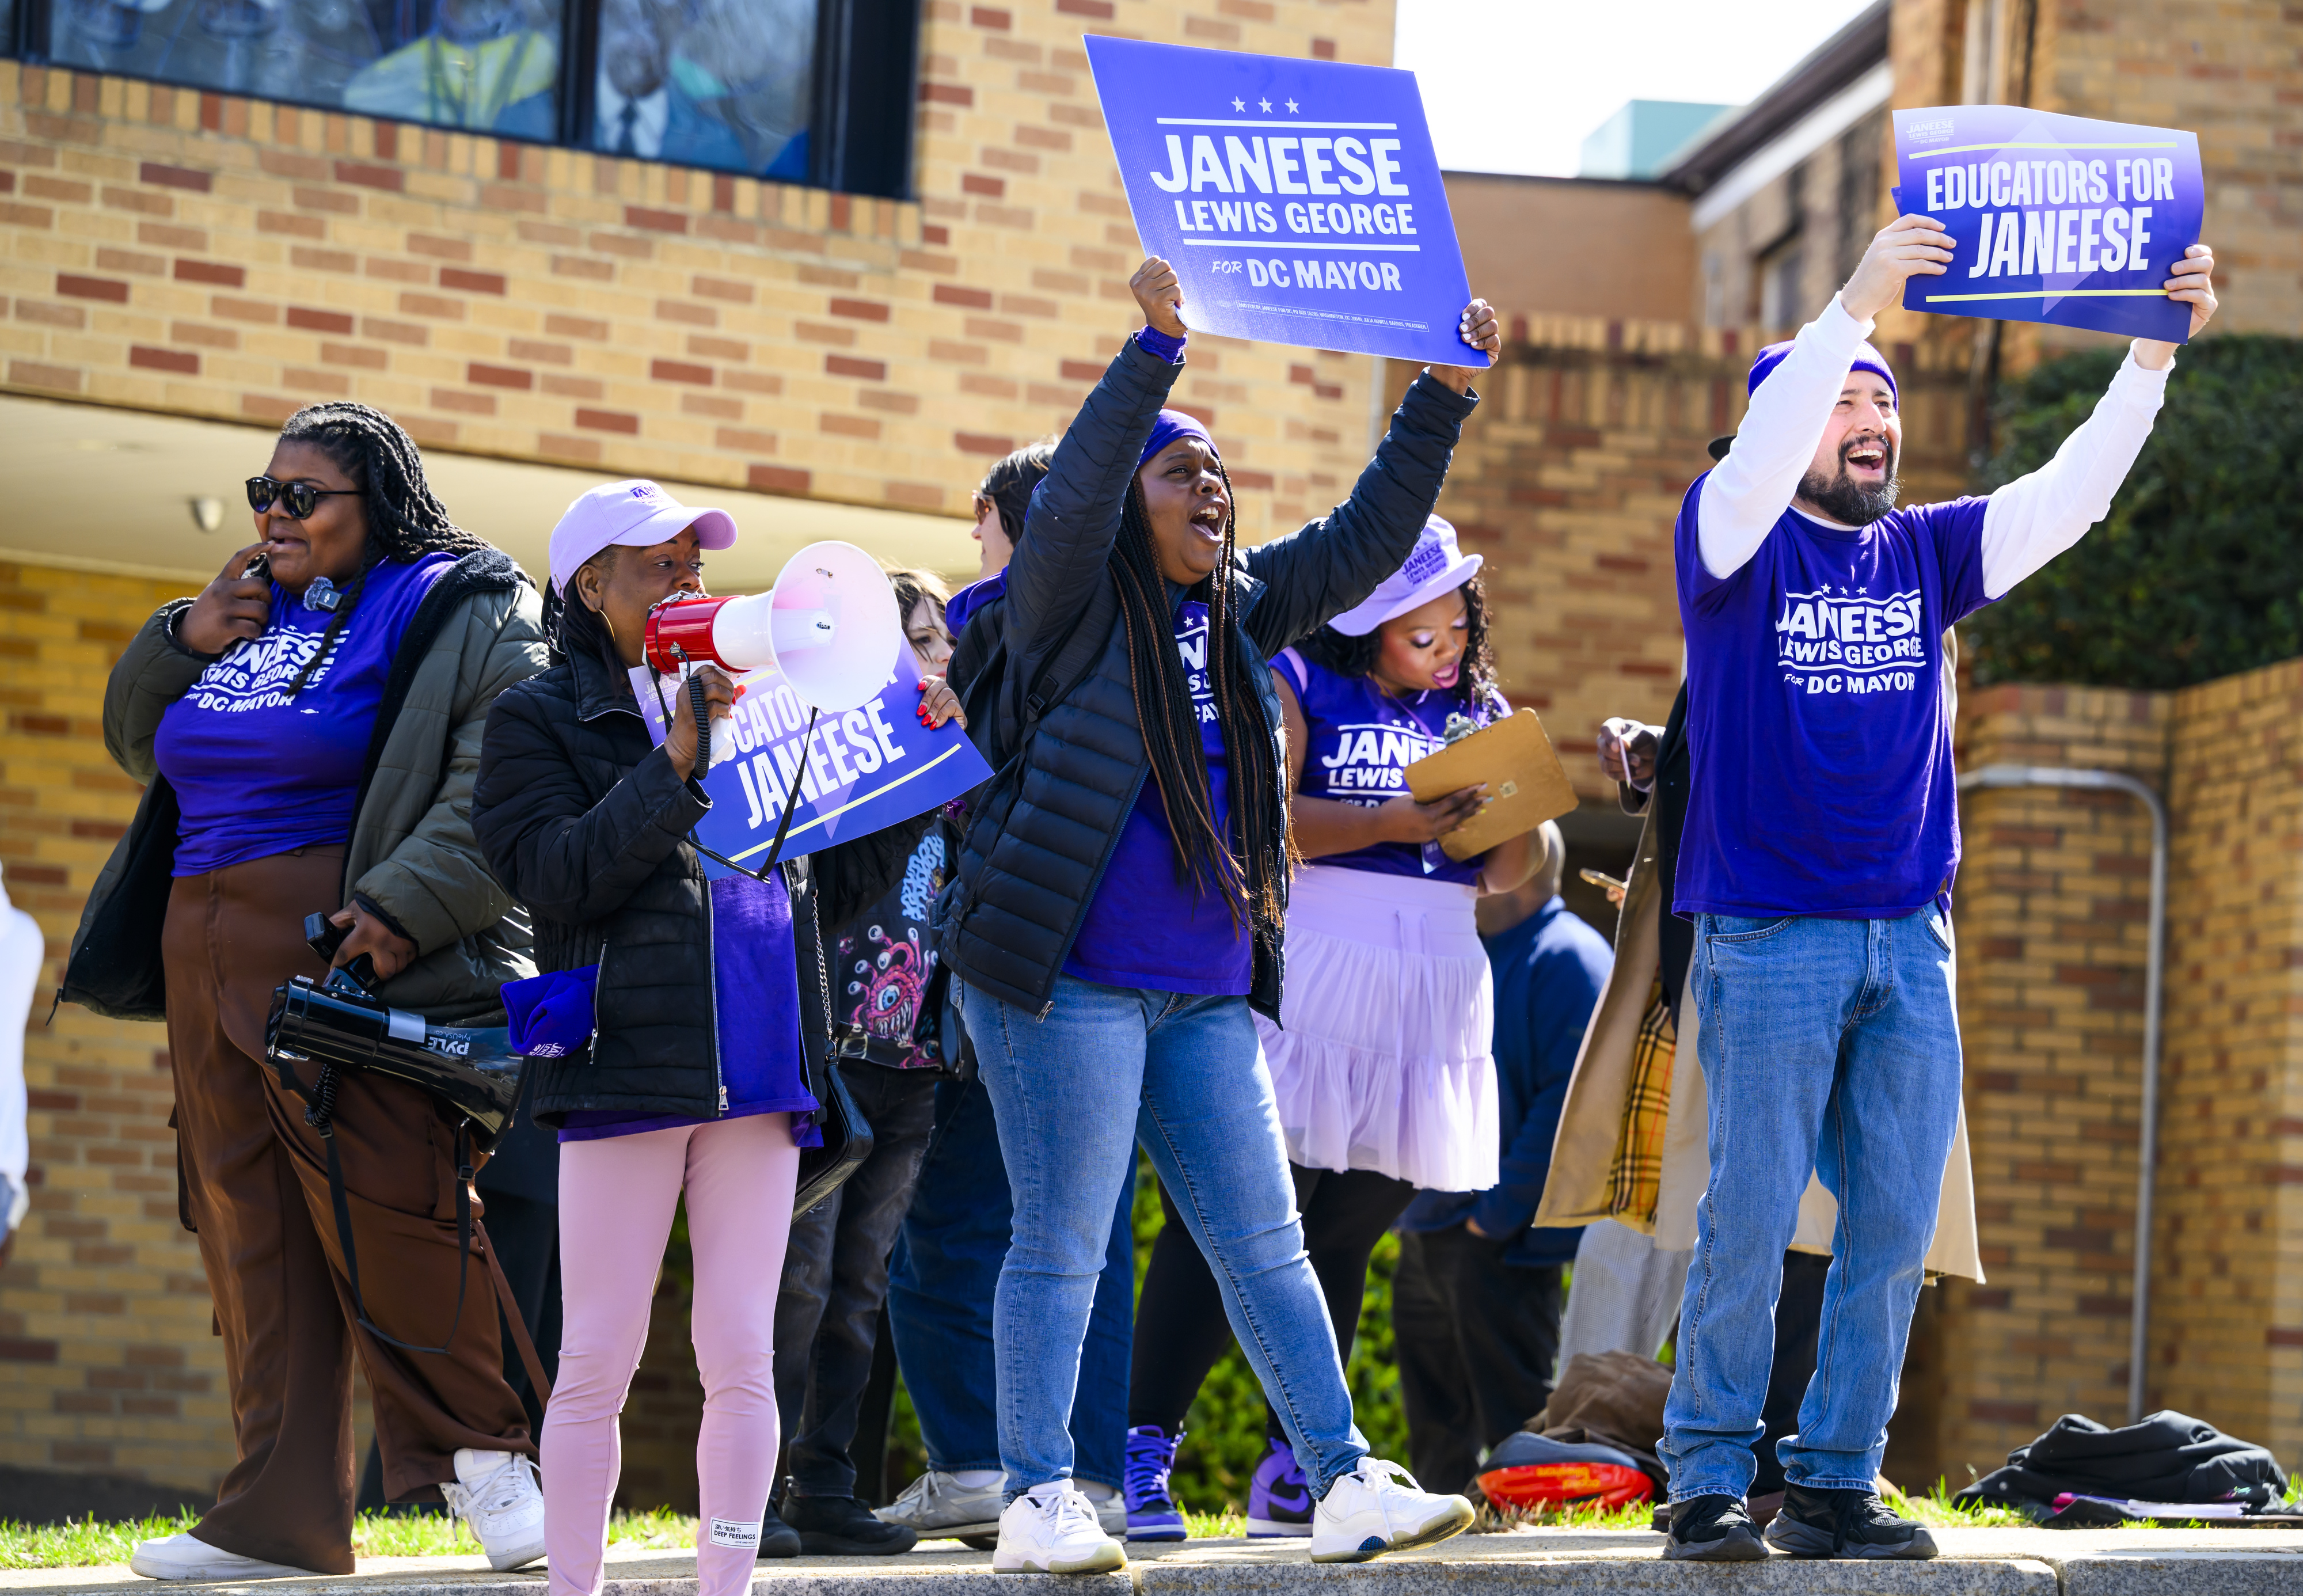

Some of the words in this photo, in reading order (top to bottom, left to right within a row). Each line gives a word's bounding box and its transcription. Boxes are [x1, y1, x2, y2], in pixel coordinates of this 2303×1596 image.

[1906, 120, 1954, 134] JANEESE
[1150, 134, 1409, 196] JANEESE
[1926, 159, 2108, 212] EDUCATORS
[2116, 158, 2174, 202] FOR
[1175, 200, 1278, 233] LEWIS
[1284, 203, 1417, 235] GEORGE
[1968, 207, 2153, 279] JANEESE
[1211, 260, 1242, 275] FOR
[1246, 259, 1290, 288] DC
[1293, 260, 1403, 291] MAYOR
[1319, 312, 1345, 320] WASHINGTON,
[1403, 543, 1442, 575] JANEESE
[1778, 636, 1842, 662] LEWIS
[1844, 636, 1924, 665] GEORGE
[1784, 674, 1805, 686] FOR
[1807, 675, 1842, 694] DC
[1846, 672, 1915, 694] MAYOR
[184, 693, 201, 701] FOR
[198, 692, 229, 711] DC
[227, 691, 296, 712] MAYOR
[736, 697, 906, 830] JANEESE
[1329, 767, 1403, 788] LEWIS
[428, 1036, 470, 1055] PYLE
[715, 1524, 741, 1533] 深い気持ち
